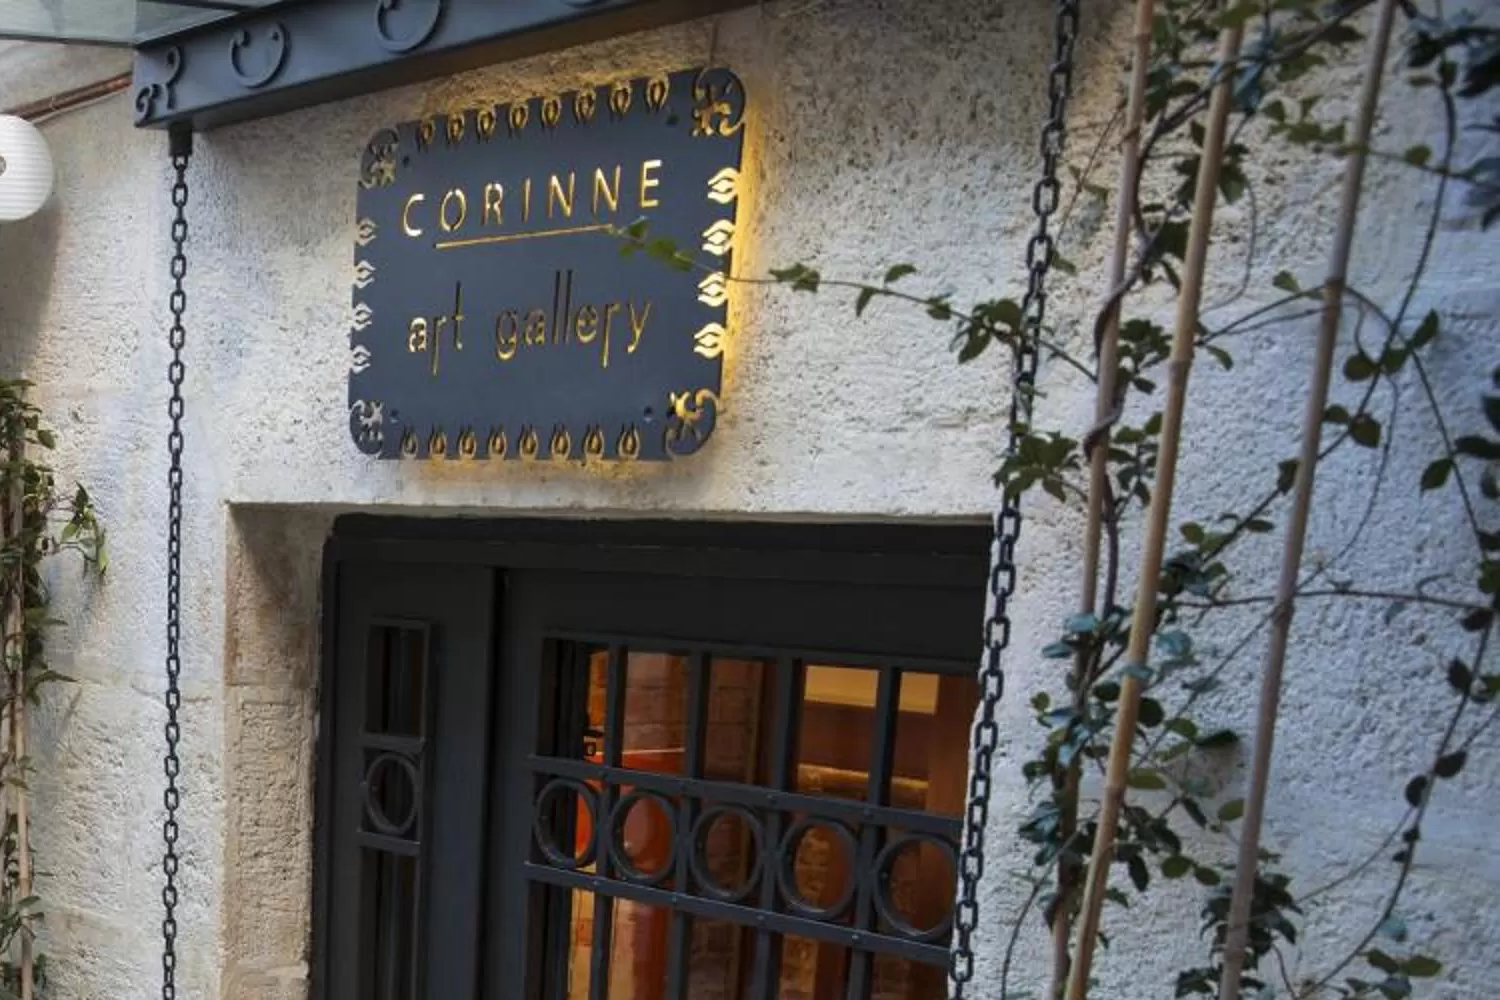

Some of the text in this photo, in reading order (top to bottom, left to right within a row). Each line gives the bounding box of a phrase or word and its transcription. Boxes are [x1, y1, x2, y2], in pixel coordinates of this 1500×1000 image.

[403, 159, 662, 237] CORINNE
[408, 269, 652, 376] art gallery
